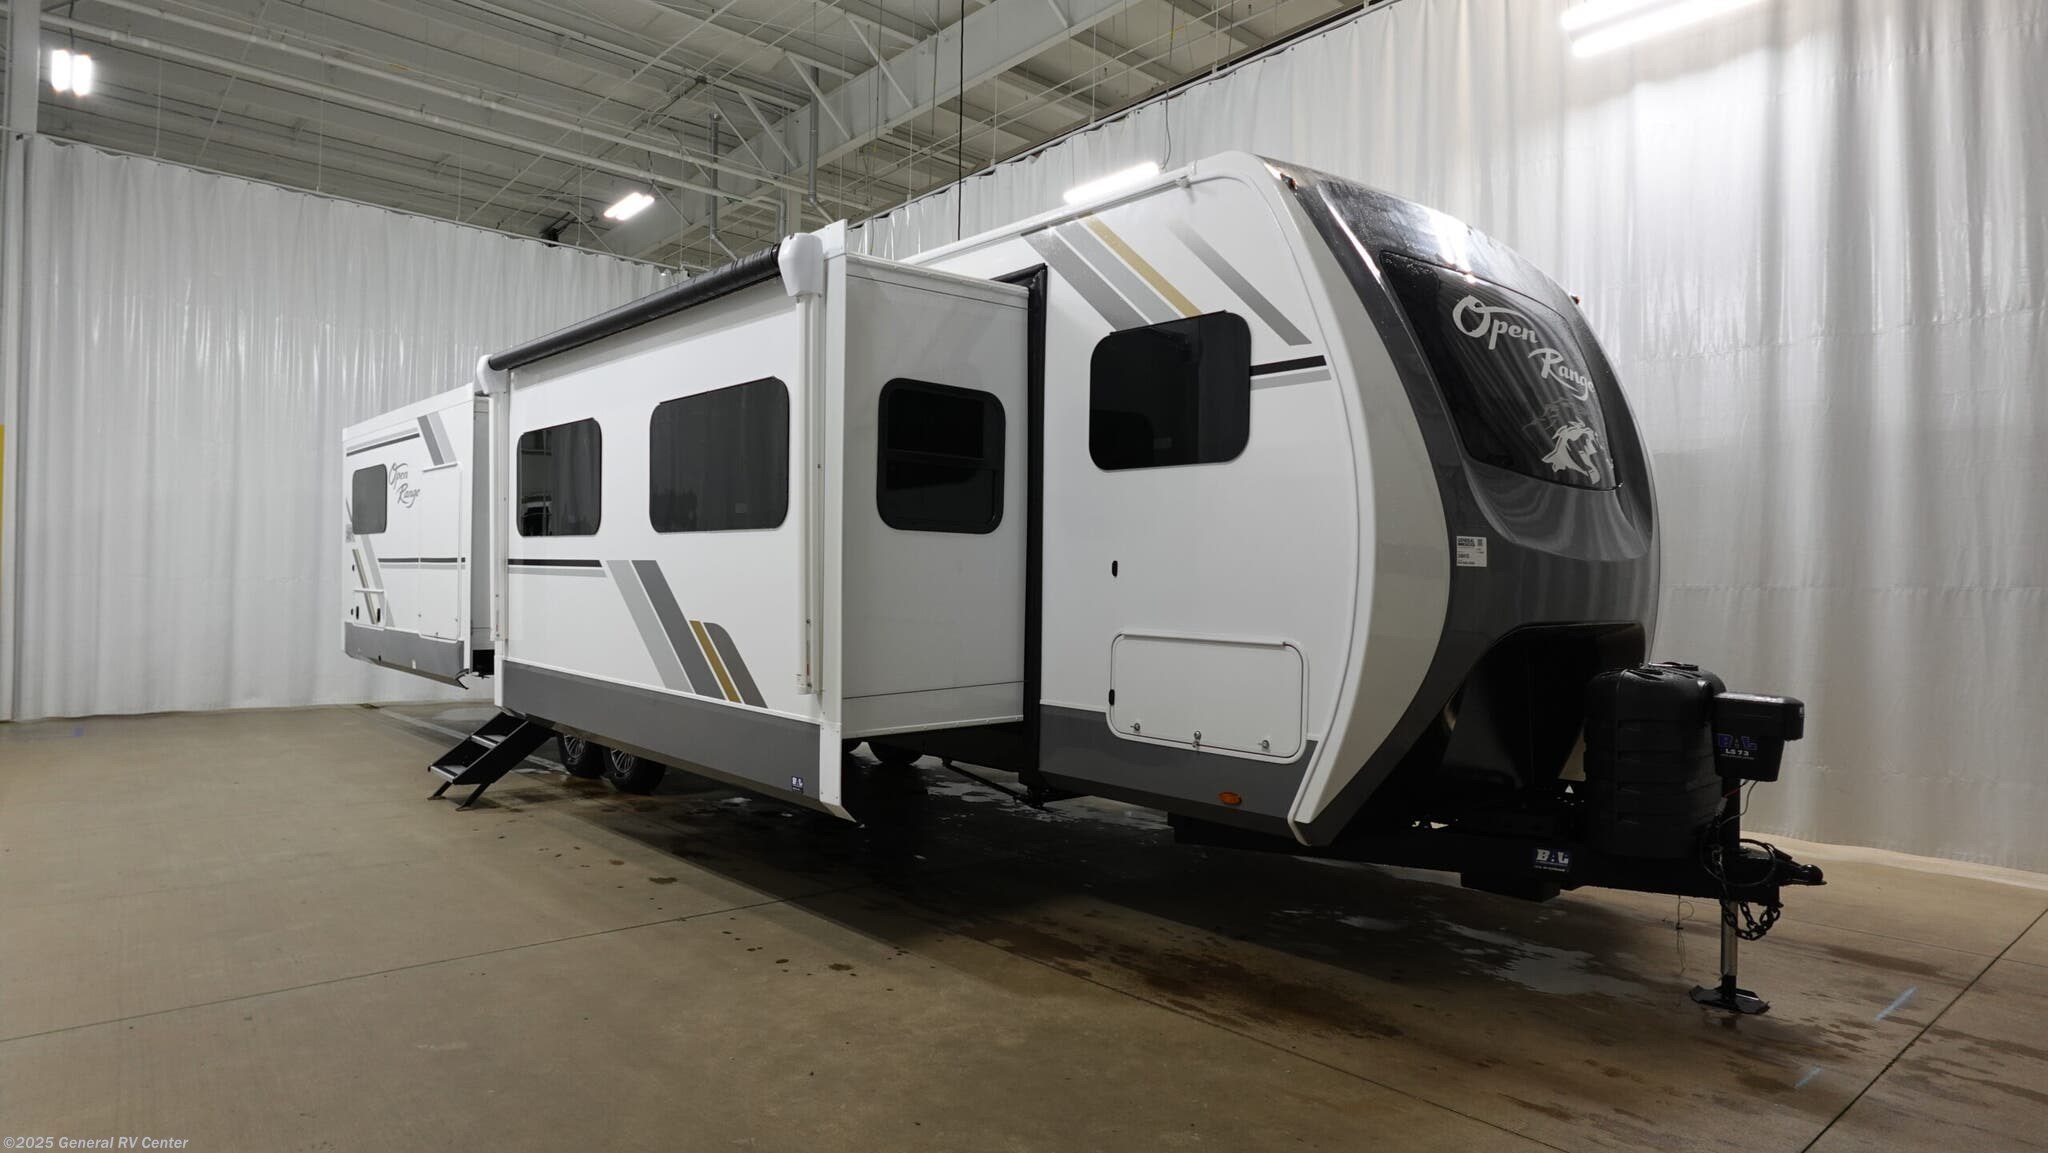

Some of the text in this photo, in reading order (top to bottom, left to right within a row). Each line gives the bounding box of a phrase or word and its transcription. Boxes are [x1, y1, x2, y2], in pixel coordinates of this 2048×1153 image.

[1452, 295, 1538, 350] Open
[1528, 348, 1595, 401] Range
[389, 462, 408, 490] Open
[396, 483, 420, 508] Range
